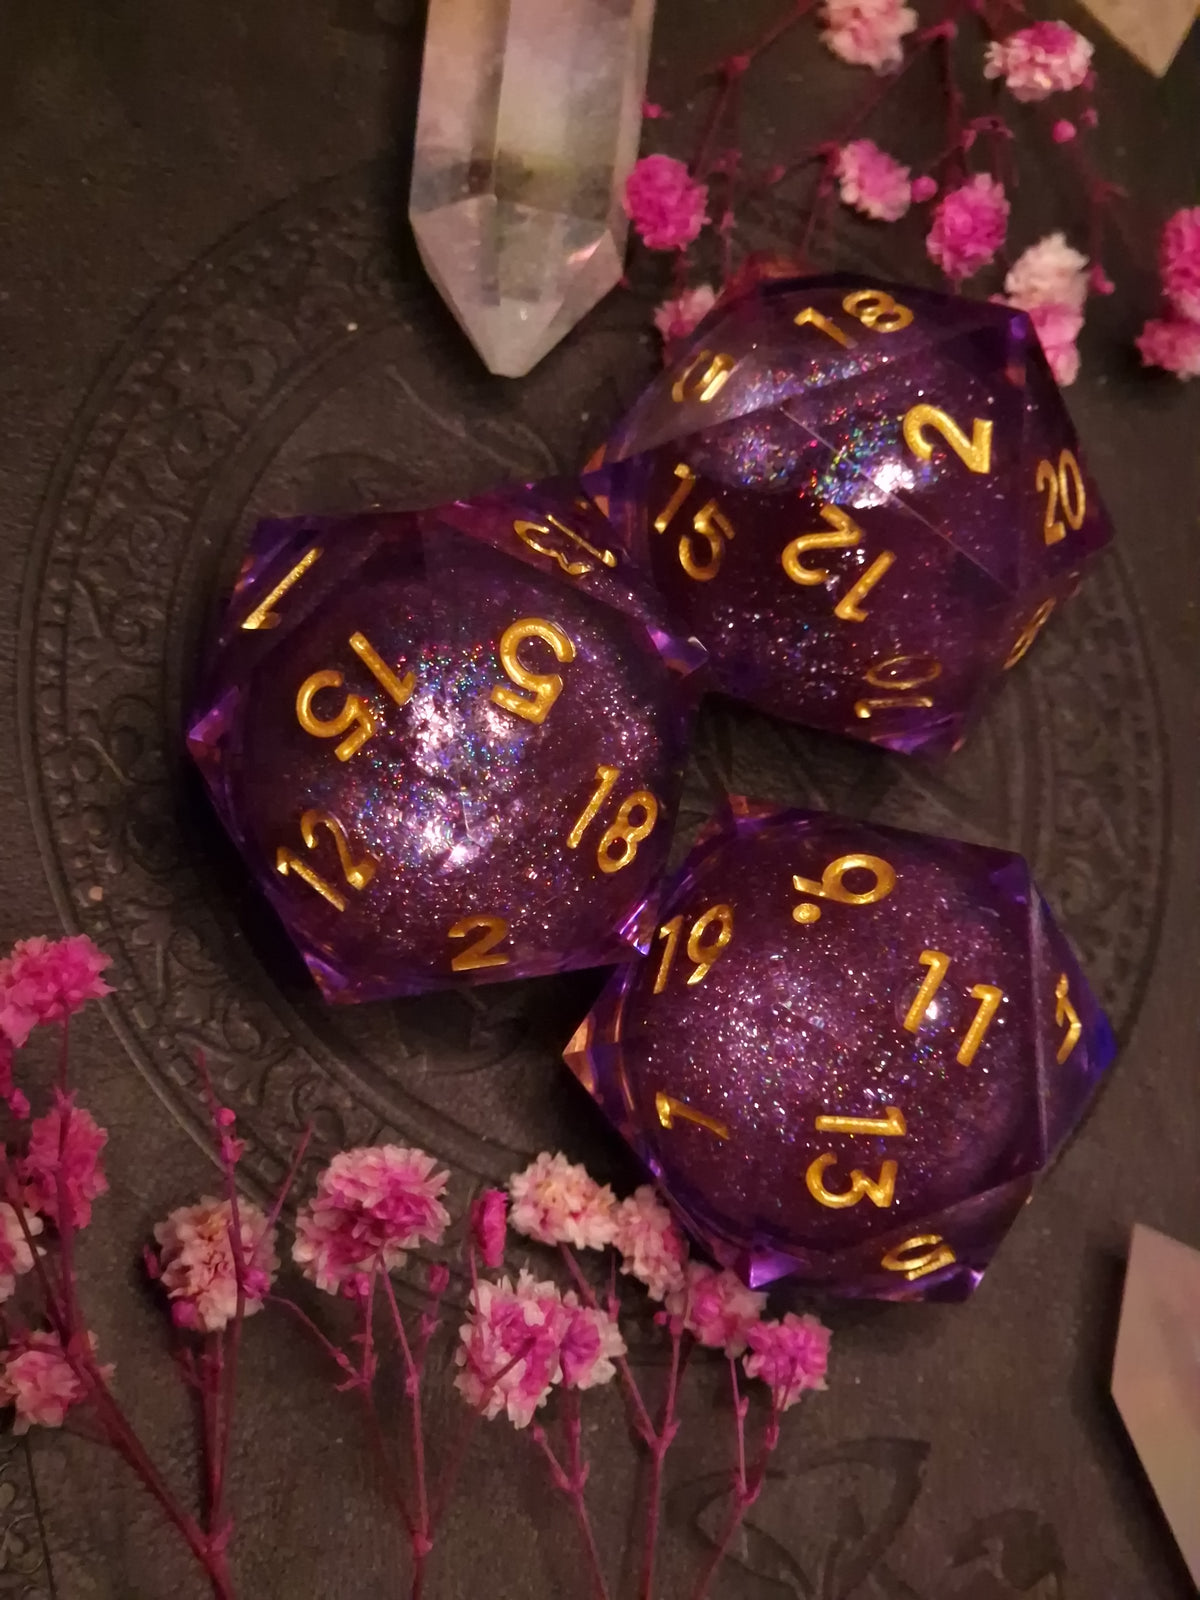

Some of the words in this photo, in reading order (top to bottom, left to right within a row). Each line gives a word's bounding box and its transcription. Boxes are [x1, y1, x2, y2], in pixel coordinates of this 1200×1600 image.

[793, 289, 915, 348] 18
[898, 402, 995, 476] 2
[653, 462, 735, 583] 15
[1035, 448, 1089, 546] 20
[780, 504, 894, 623] 12
[292, 631, 416, 763] 15
[490, 616, 579, 726] 5
[855, 653, 942, 722] 10
[275, 809, 376, 913] 12
[566, 764, 660, 875] 18
[447, 917, 511, 972] 2
[652, 904, 735, 996] 19
[902, 949, 1006, 1068] 11
[805, 1106, 908, 1210] 13
